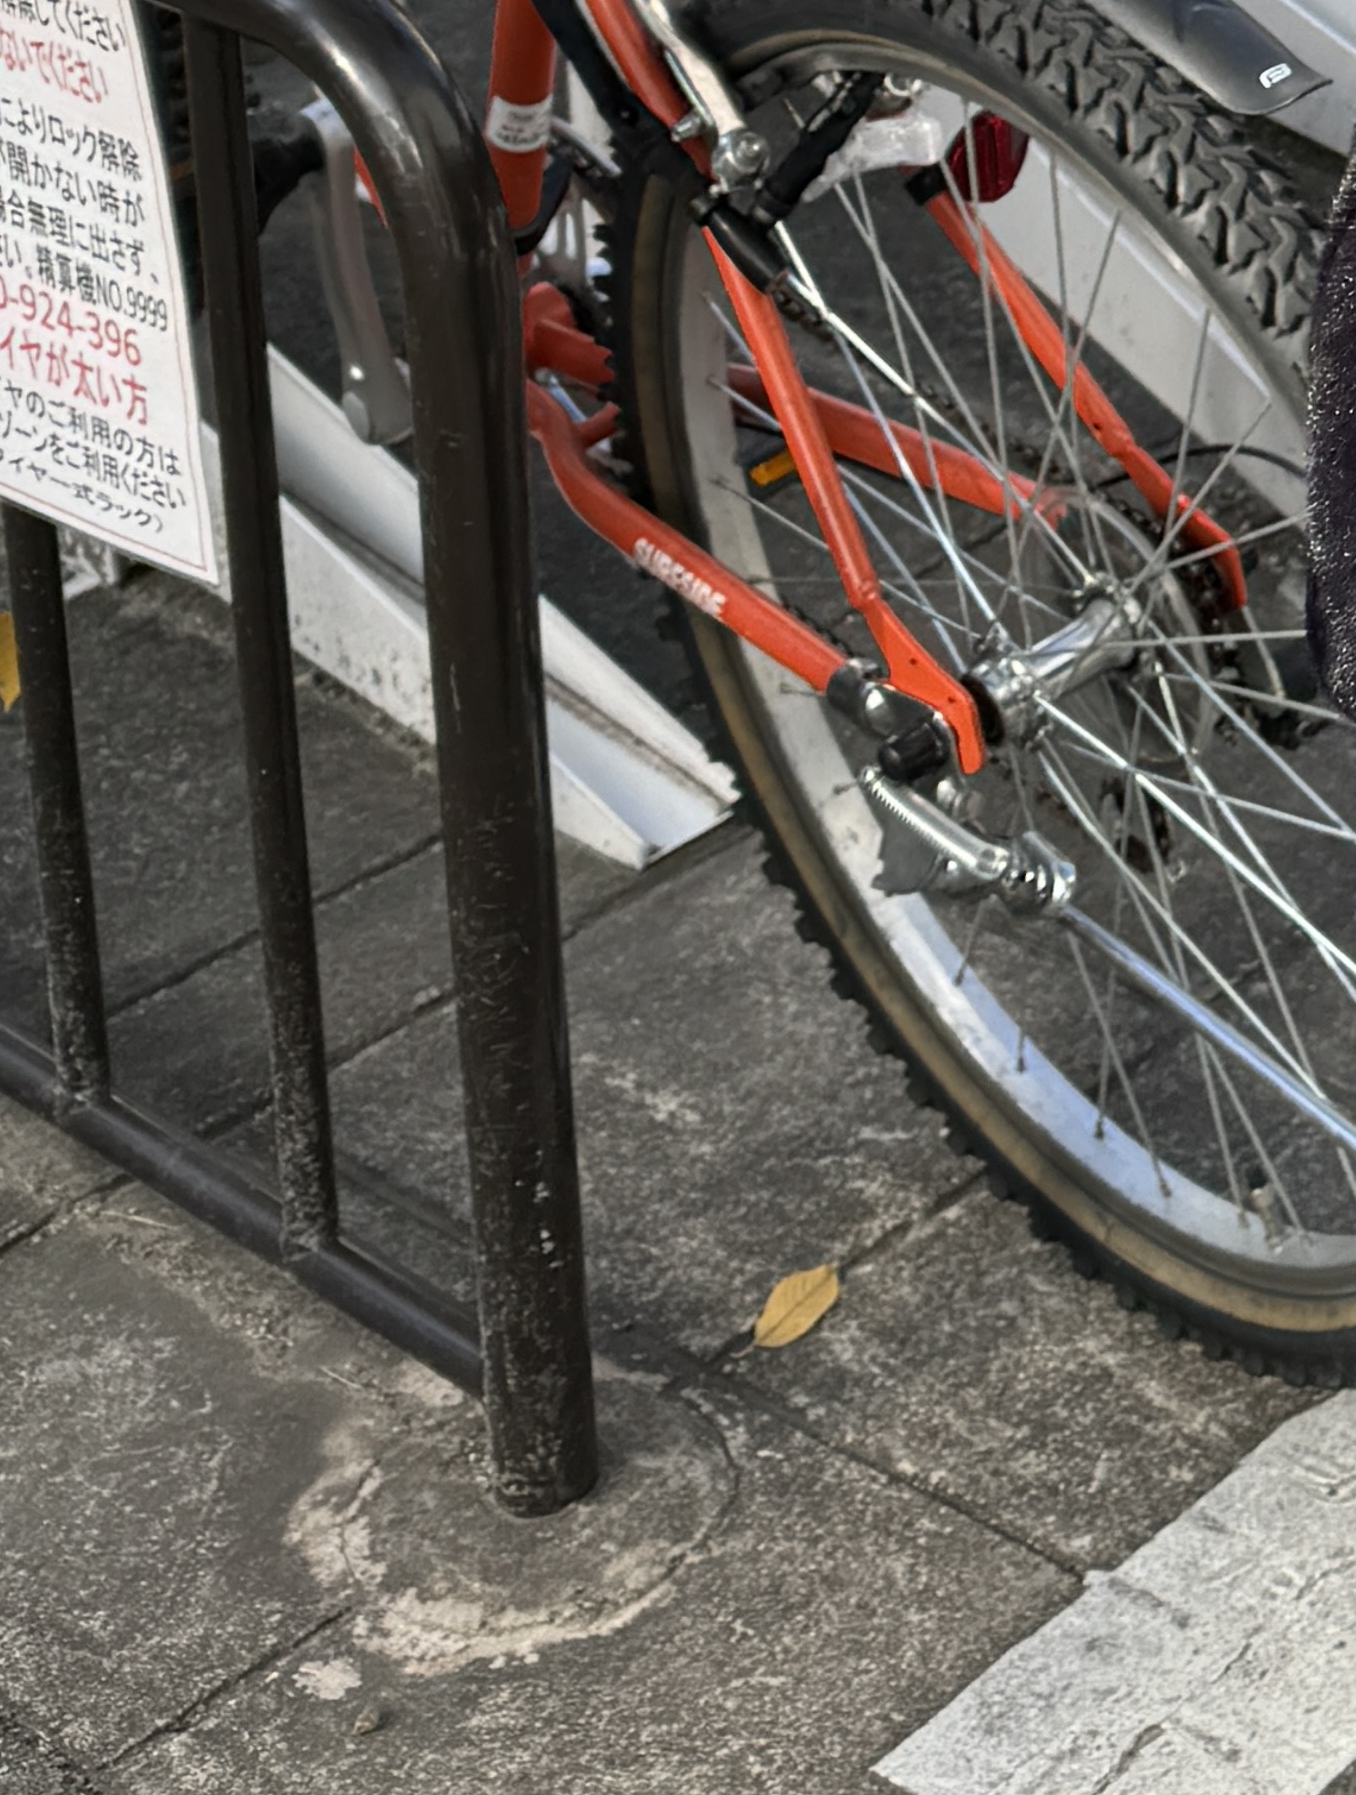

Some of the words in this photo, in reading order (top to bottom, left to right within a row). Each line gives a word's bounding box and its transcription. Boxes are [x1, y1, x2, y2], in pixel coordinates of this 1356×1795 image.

[0, 136, 145, 227] 開かない時が
[0, 185, 158, 285] 合無理に出さず、
